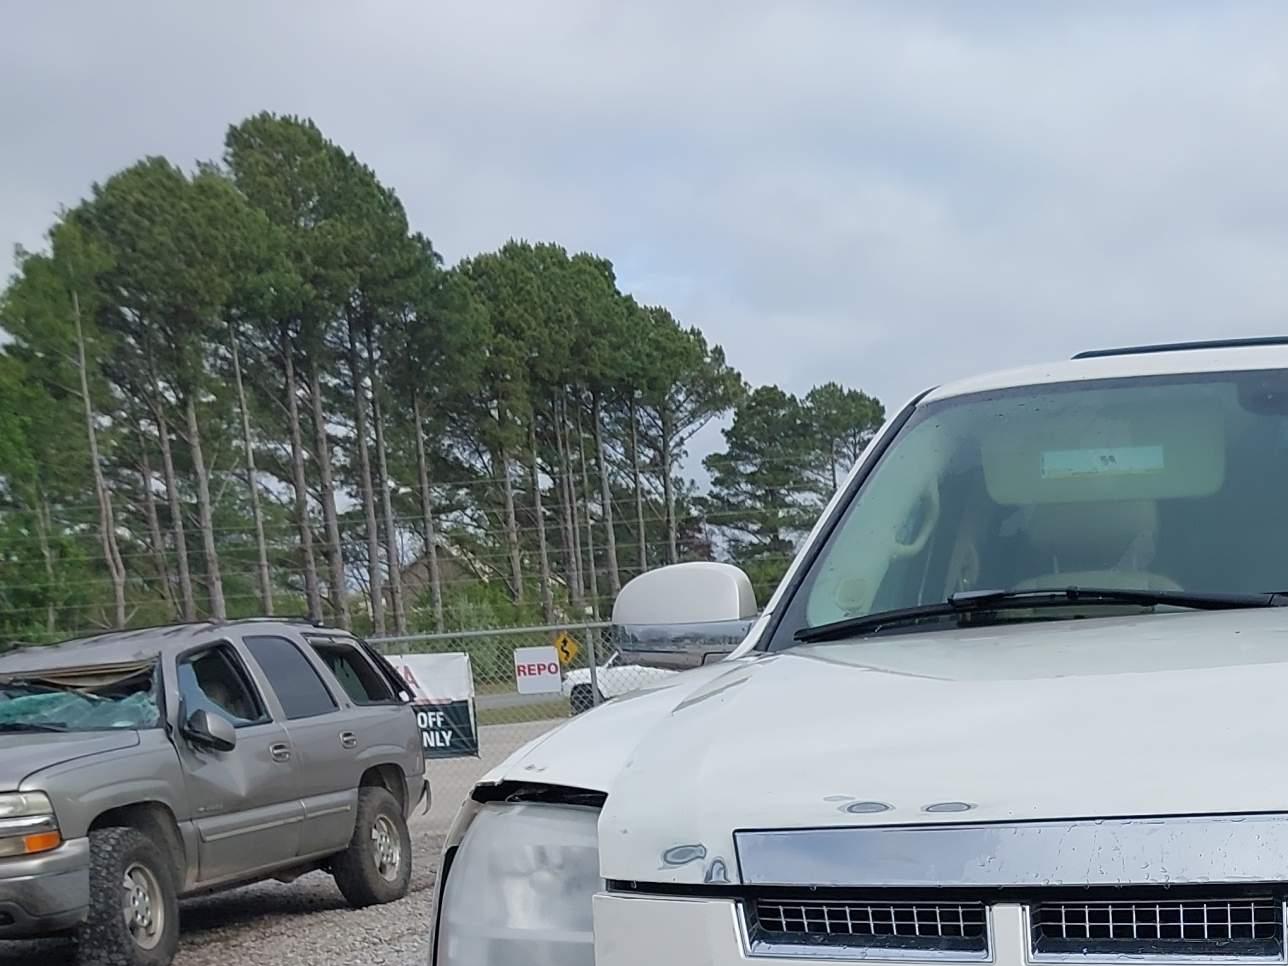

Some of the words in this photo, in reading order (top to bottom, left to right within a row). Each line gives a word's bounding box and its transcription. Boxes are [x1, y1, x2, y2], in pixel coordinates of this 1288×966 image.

[404, 665, 420, 689] A
[516, 662, 559, 677] REPO
[416, 711, 444, 729] OFF
[422, 730, 453, 748] NLY
